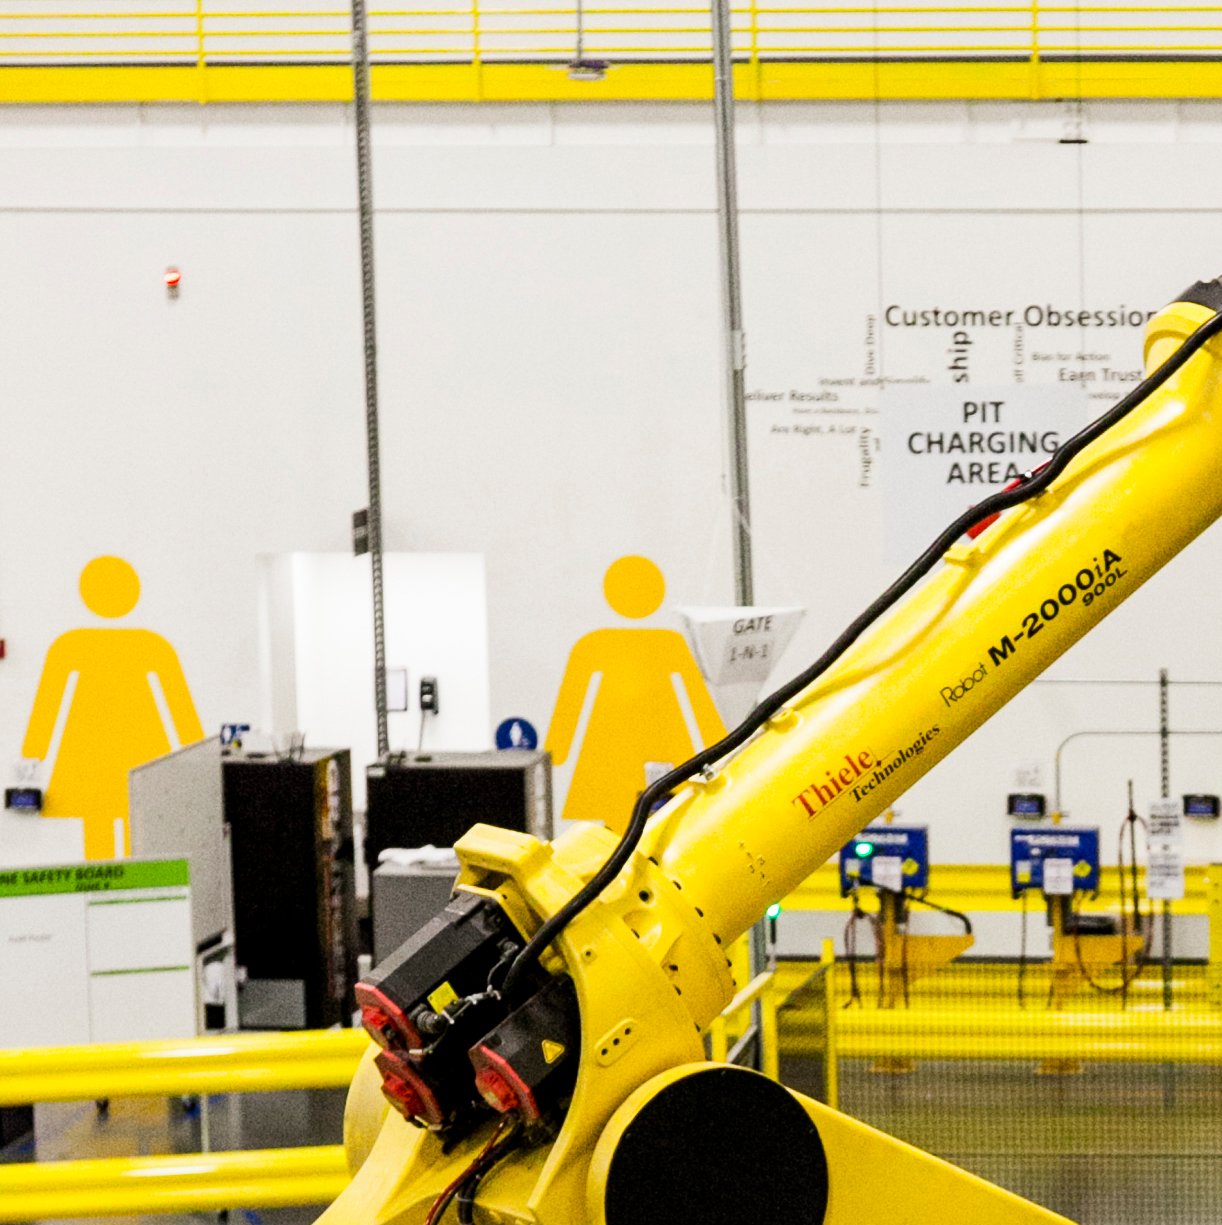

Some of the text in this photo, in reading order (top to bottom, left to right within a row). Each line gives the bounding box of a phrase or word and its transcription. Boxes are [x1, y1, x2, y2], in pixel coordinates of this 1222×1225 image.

[885, 305, 1014, 327] Customer
[947, 331, 972, 383] ship
[1101, 367, 1142, 382] Trust
[744, 389, 783, 401] eliver
[962, 401, 1005, 424] PIT
[907, 432, 1059, 454] CHARGING
[947, 462, 1021, 484] AREA
[1081, 566, 1128, 607] 900L
[733, 616, 773, 634] GATE
[940, 549, 1122, 707] Robot M-2000iA
[849, 723, 941, 803] Technologies
[791, 748, 874, 818] Thiele
